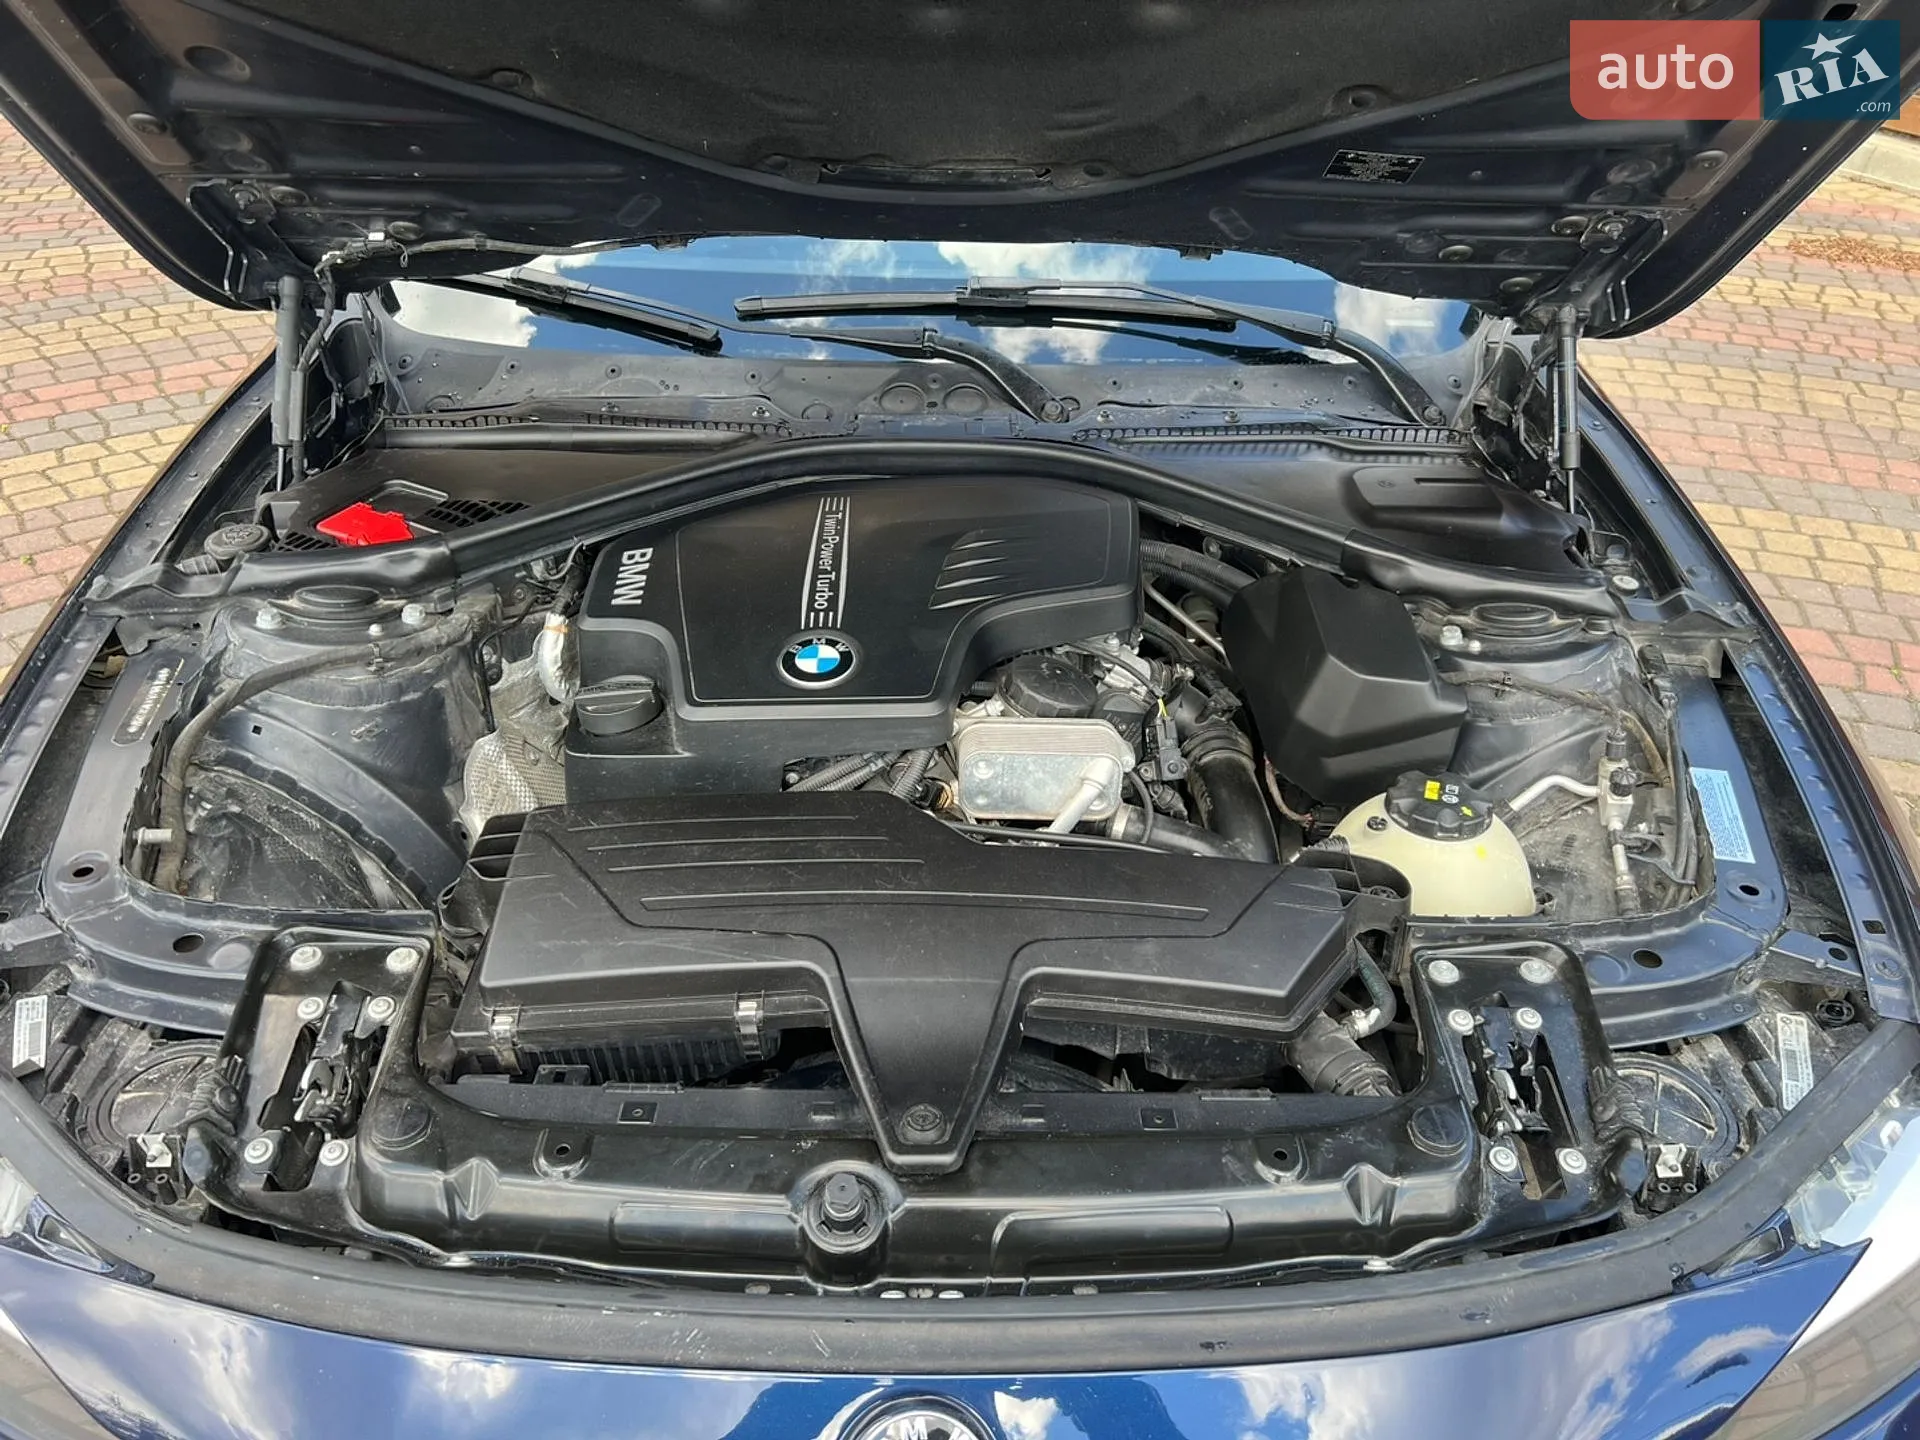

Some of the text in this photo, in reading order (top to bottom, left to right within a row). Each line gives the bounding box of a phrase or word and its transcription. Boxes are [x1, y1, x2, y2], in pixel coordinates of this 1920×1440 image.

[611, 547, 654, 605] BMW
[814, 512, 843, 610] TwinPower Turbo
[788, 637, 850, 654] BMW
